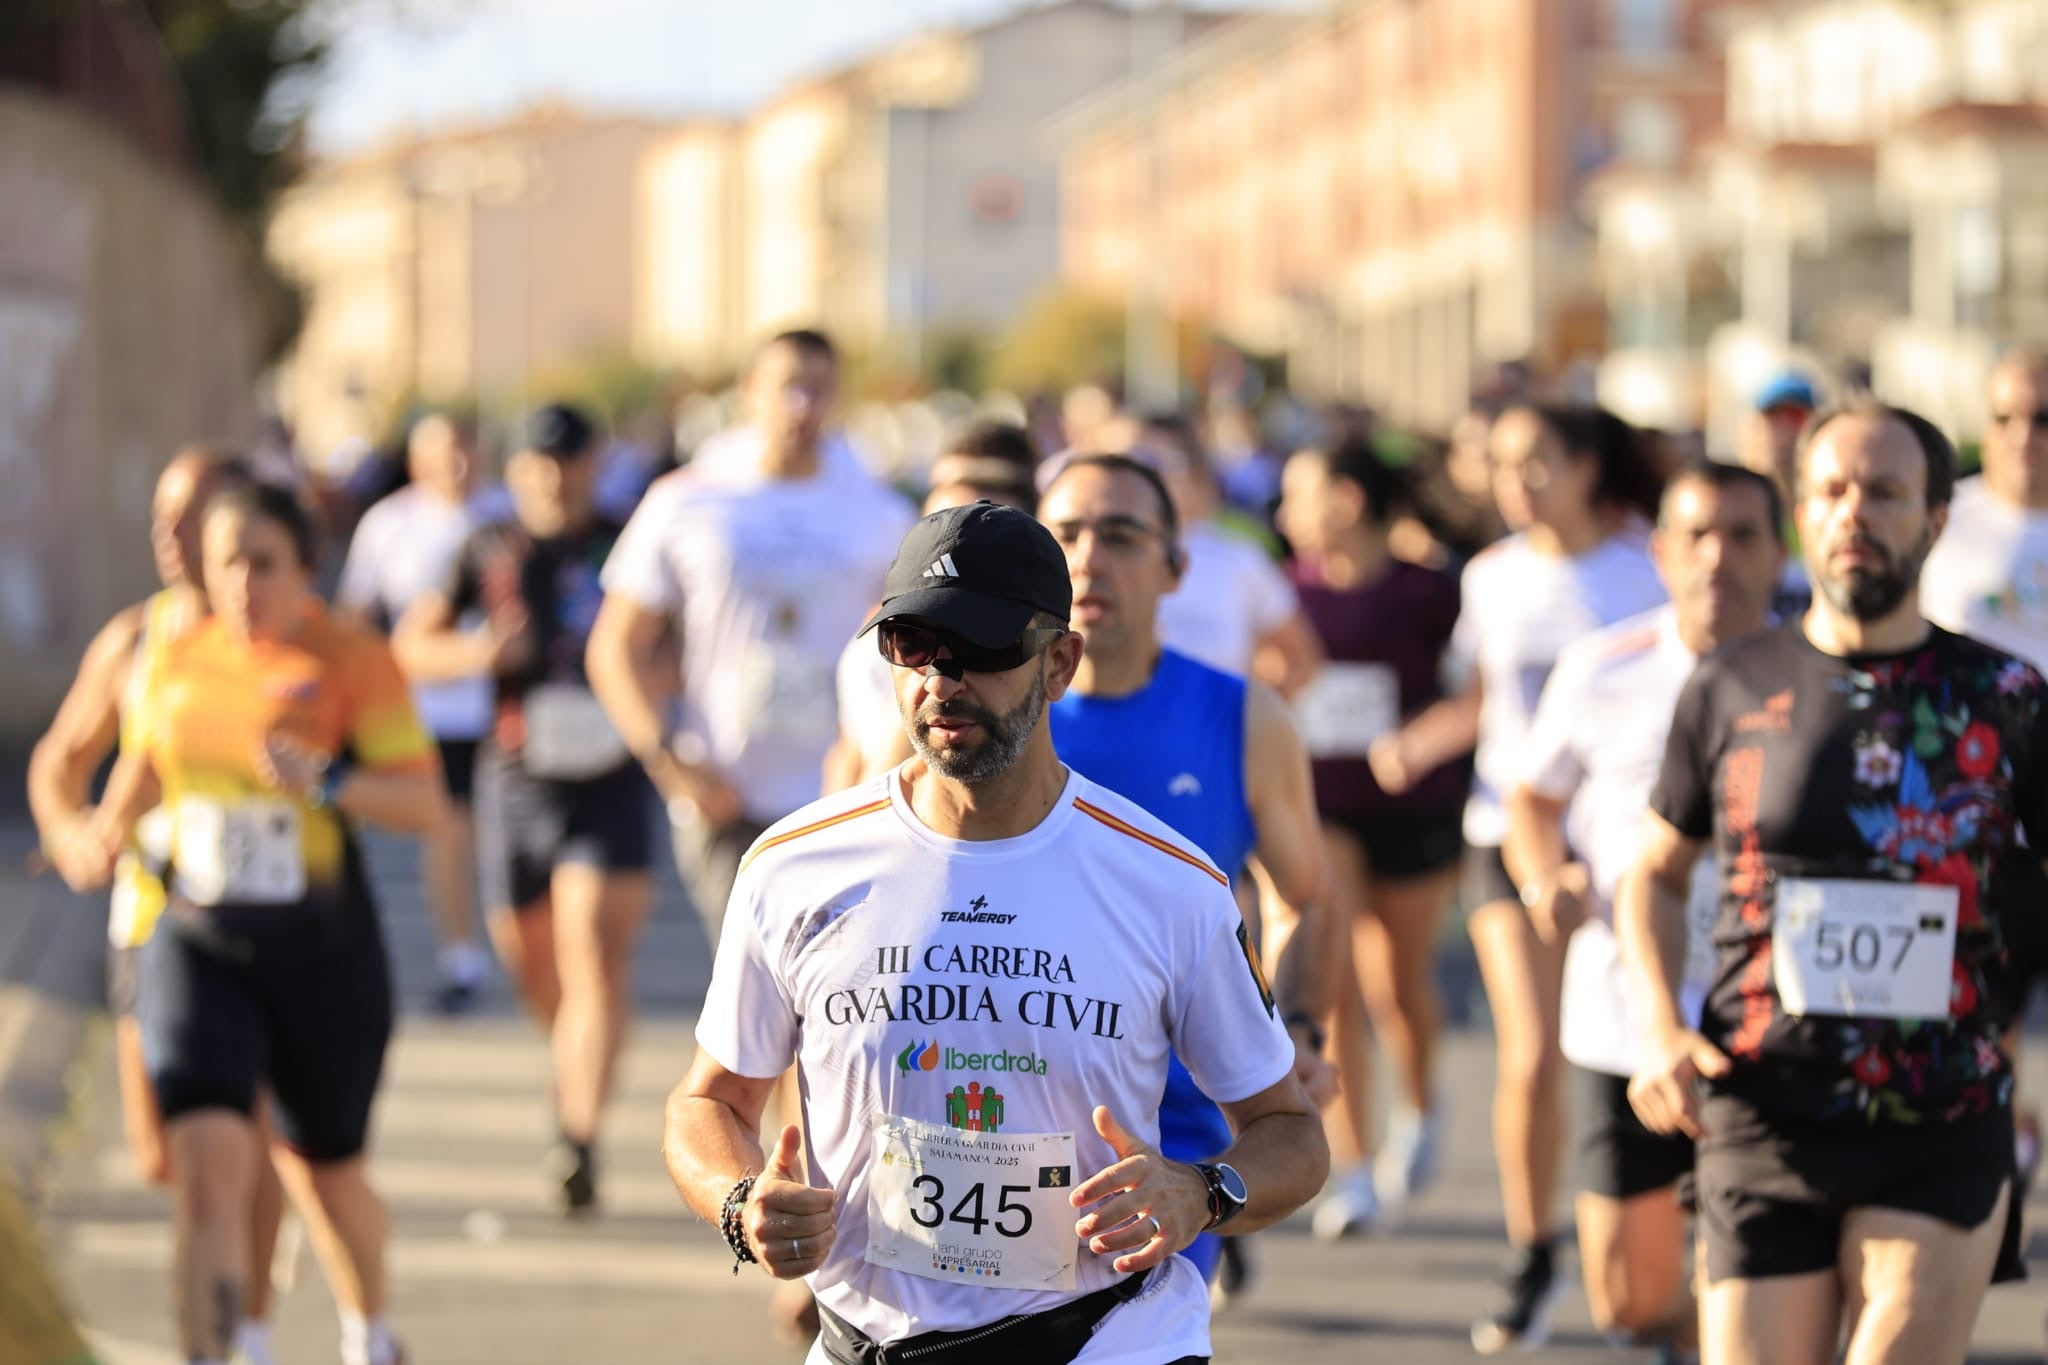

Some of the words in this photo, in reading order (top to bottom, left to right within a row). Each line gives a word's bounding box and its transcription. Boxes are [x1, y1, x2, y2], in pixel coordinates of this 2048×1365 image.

[940, 911, 1018, 925] TEAMERGY
[1814, 921, 1916, 976] 507
[876, 944, 912, 975] III
[923, 943, 1077, 984] CARRERA
[824, 983, 1003, 1026] GVARDIA
[1018, 989, 1125, 1041] CIVIL
[945, 1047, 1048, 1077] Iberdrola
[929, 1148, 991, 1165] SALAMANCA
[993, 1156, 1020, 1167] 2025
[1011, 1142, 1036, 1152] CIVIL
[910, 1174, 1033, 1238] 345
[932, 1253, 1001, 1270] EMPRESARIAL
[962, 1246, 1003, 1260] grupo
